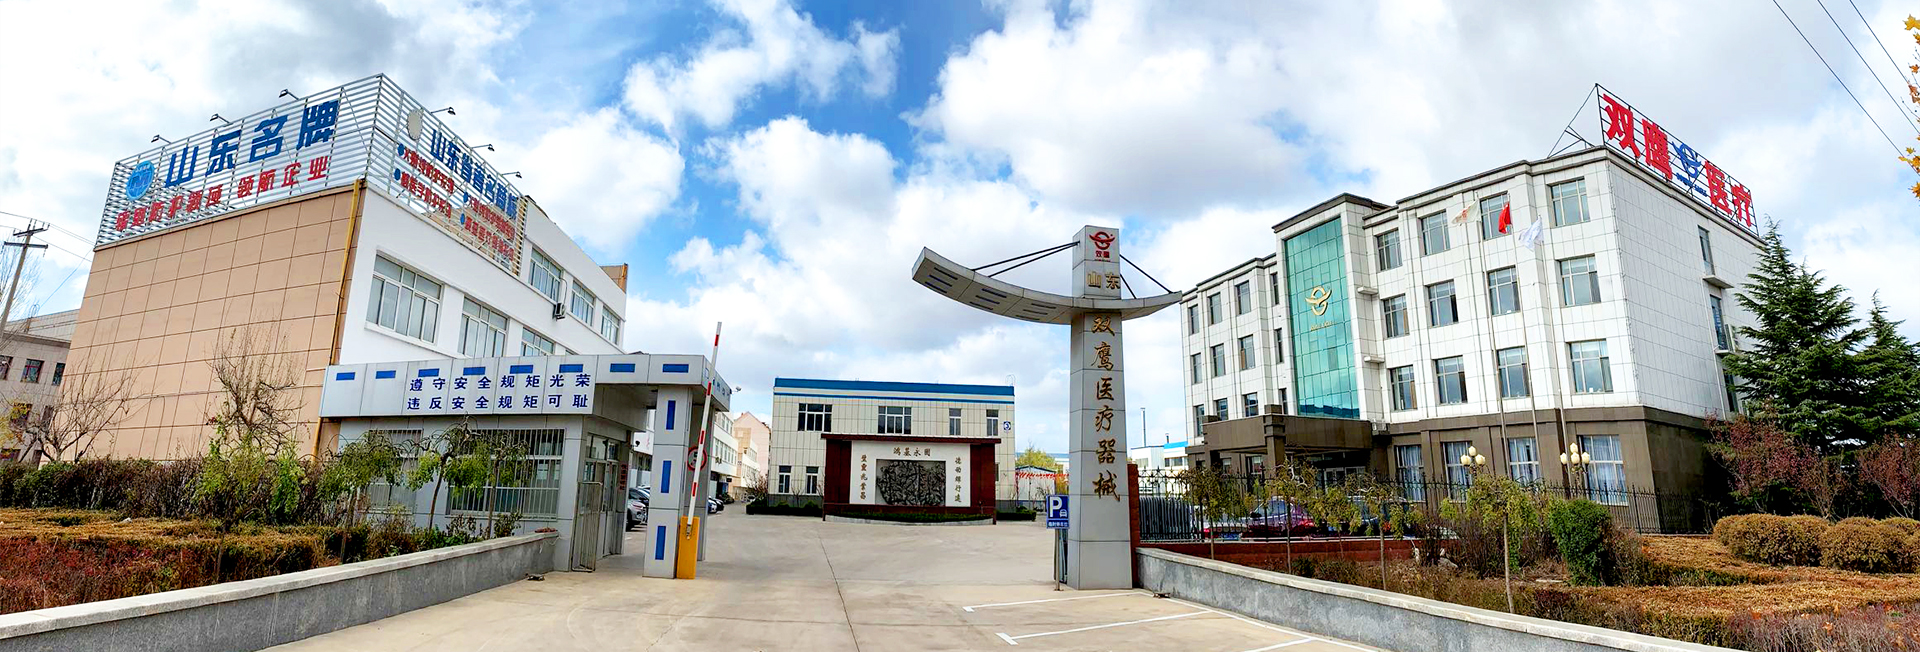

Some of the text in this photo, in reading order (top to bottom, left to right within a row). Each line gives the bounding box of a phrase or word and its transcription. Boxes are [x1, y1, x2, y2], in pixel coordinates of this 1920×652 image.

[165, 98, 340, 189] 山东名牌
[1602, 93, 1753, 228] 双鹰 医疗
[237, 155, 329, 198] 领航企业
[430, 128, 517, 220] 山东省著名商标
[1086, 271, 1121, 290] 山东
[407, 394, 589, 410] 违反安全规矩可耻
[409, 374, 591, 392] 遵守安全规矩光荣
[1091, 314, 1121, 502] 双鹰医疗器械
[1049, 496, 1063, 518] P
